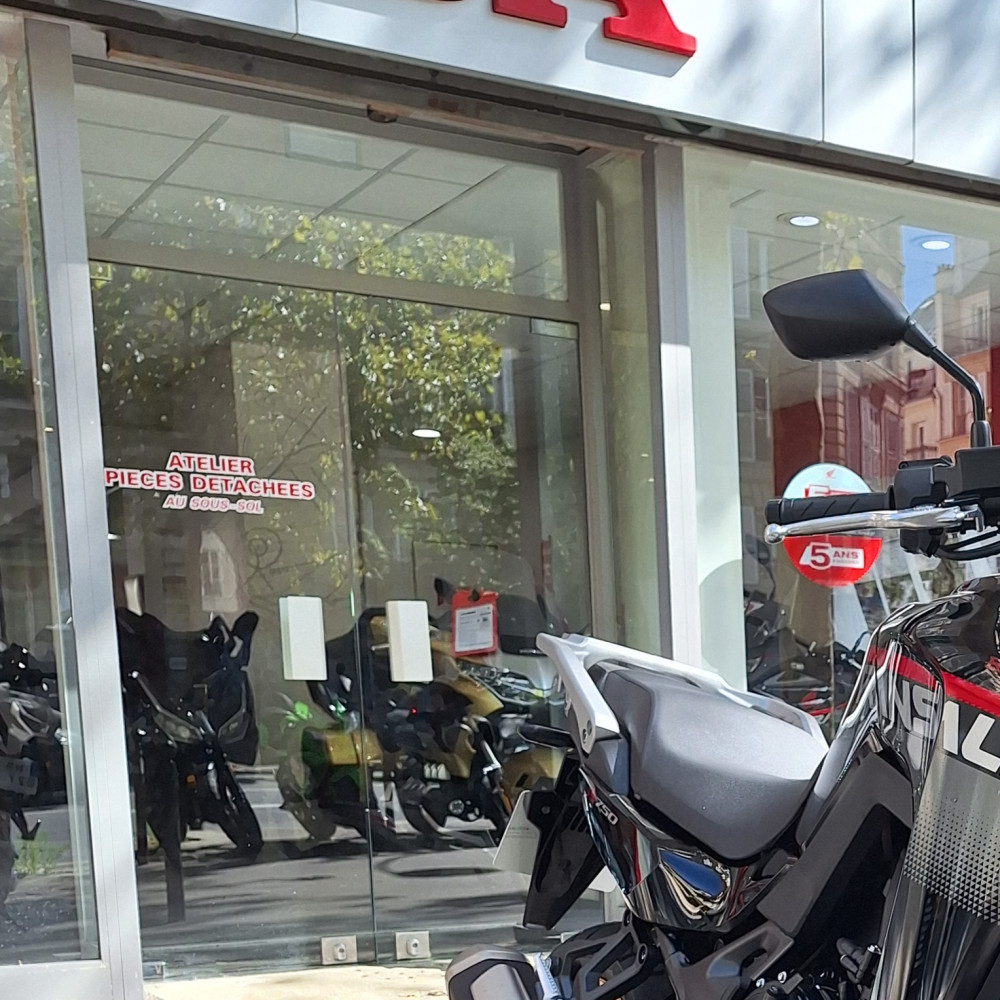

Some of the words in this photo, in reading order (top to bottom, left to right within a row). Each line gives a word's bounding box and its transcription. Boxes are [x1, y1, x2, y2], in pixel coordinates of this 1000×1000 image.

[167, 453, 255, 475] ATELIER
[104, 467, 182, 490] PIECES
[191, 474, 315, 499] DETACHEES
[163, 494, 187, 509] AU
[810, 543, 831, 569] 5
[832, 550, 859, 559] ANS
